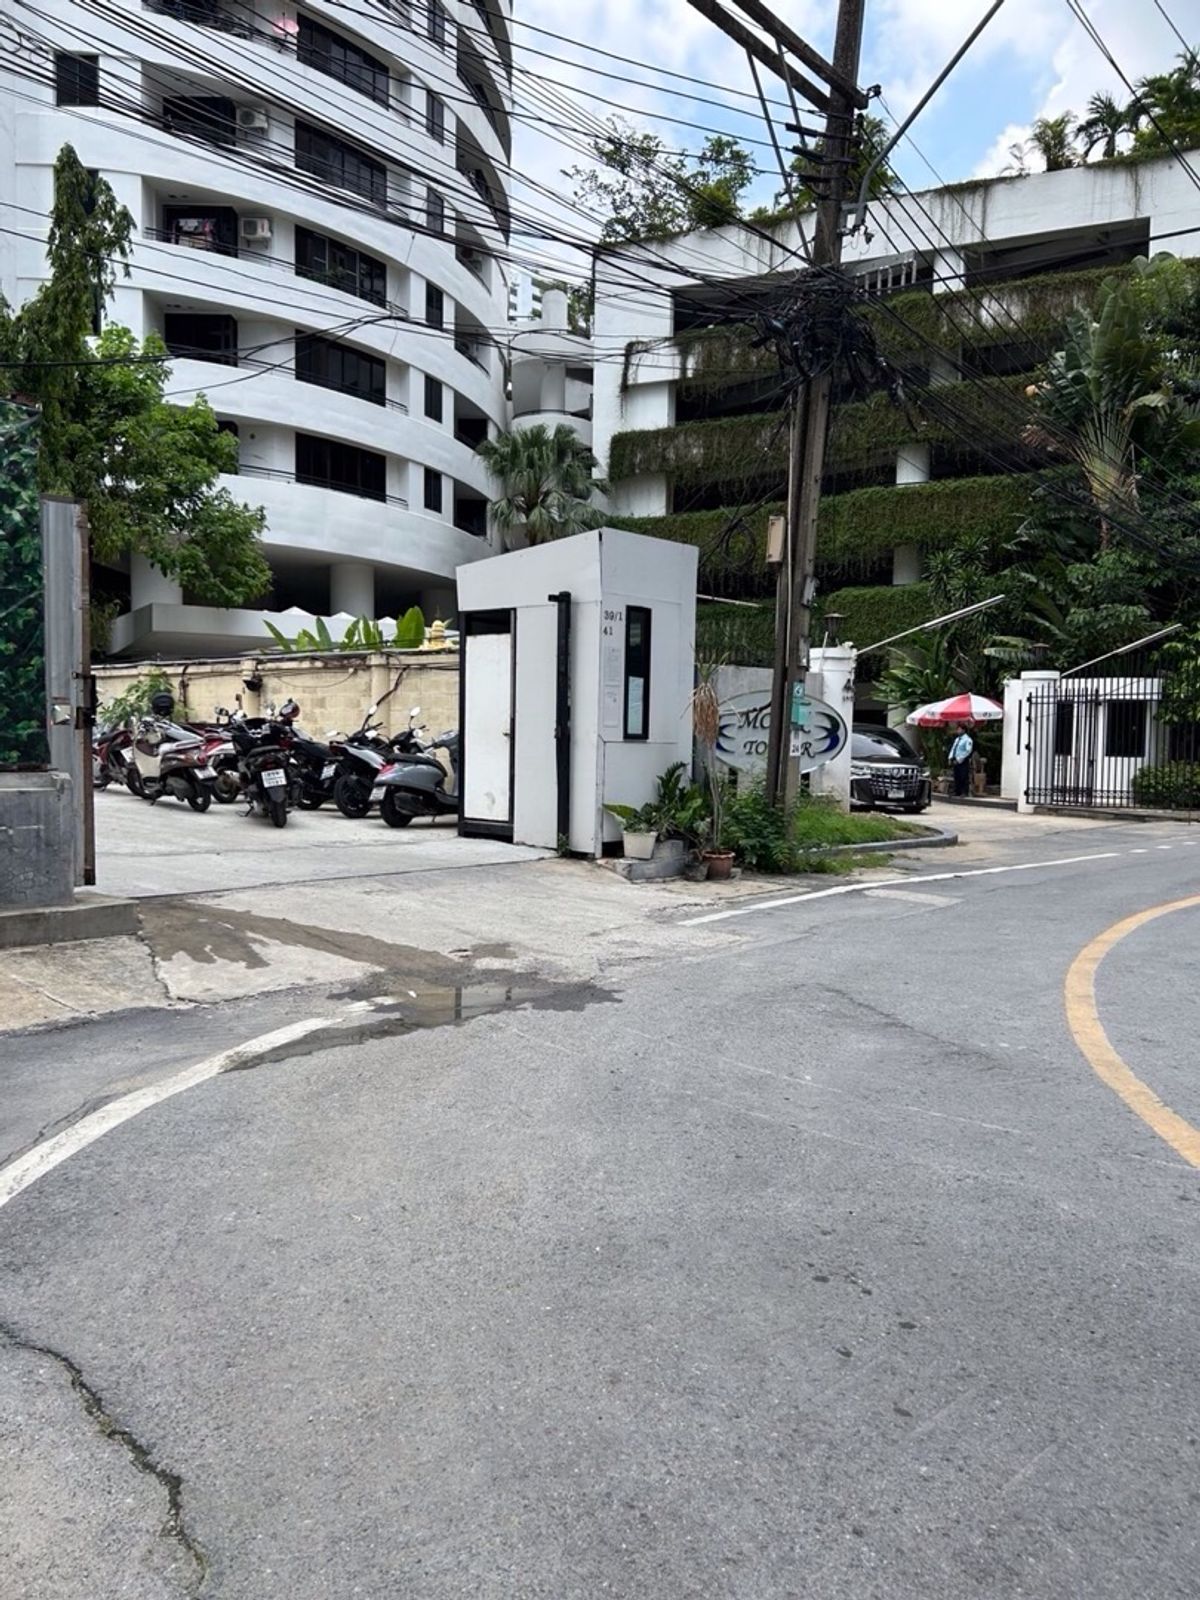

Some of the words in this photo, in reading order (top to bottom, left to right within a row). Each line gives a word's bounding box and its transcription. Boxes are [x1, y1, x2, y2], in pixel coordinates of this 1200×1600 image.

[603, 610, 623, 621] 39/1
[603, 626, 613, 636] 41
[743, 740, 815, 758] TOR
